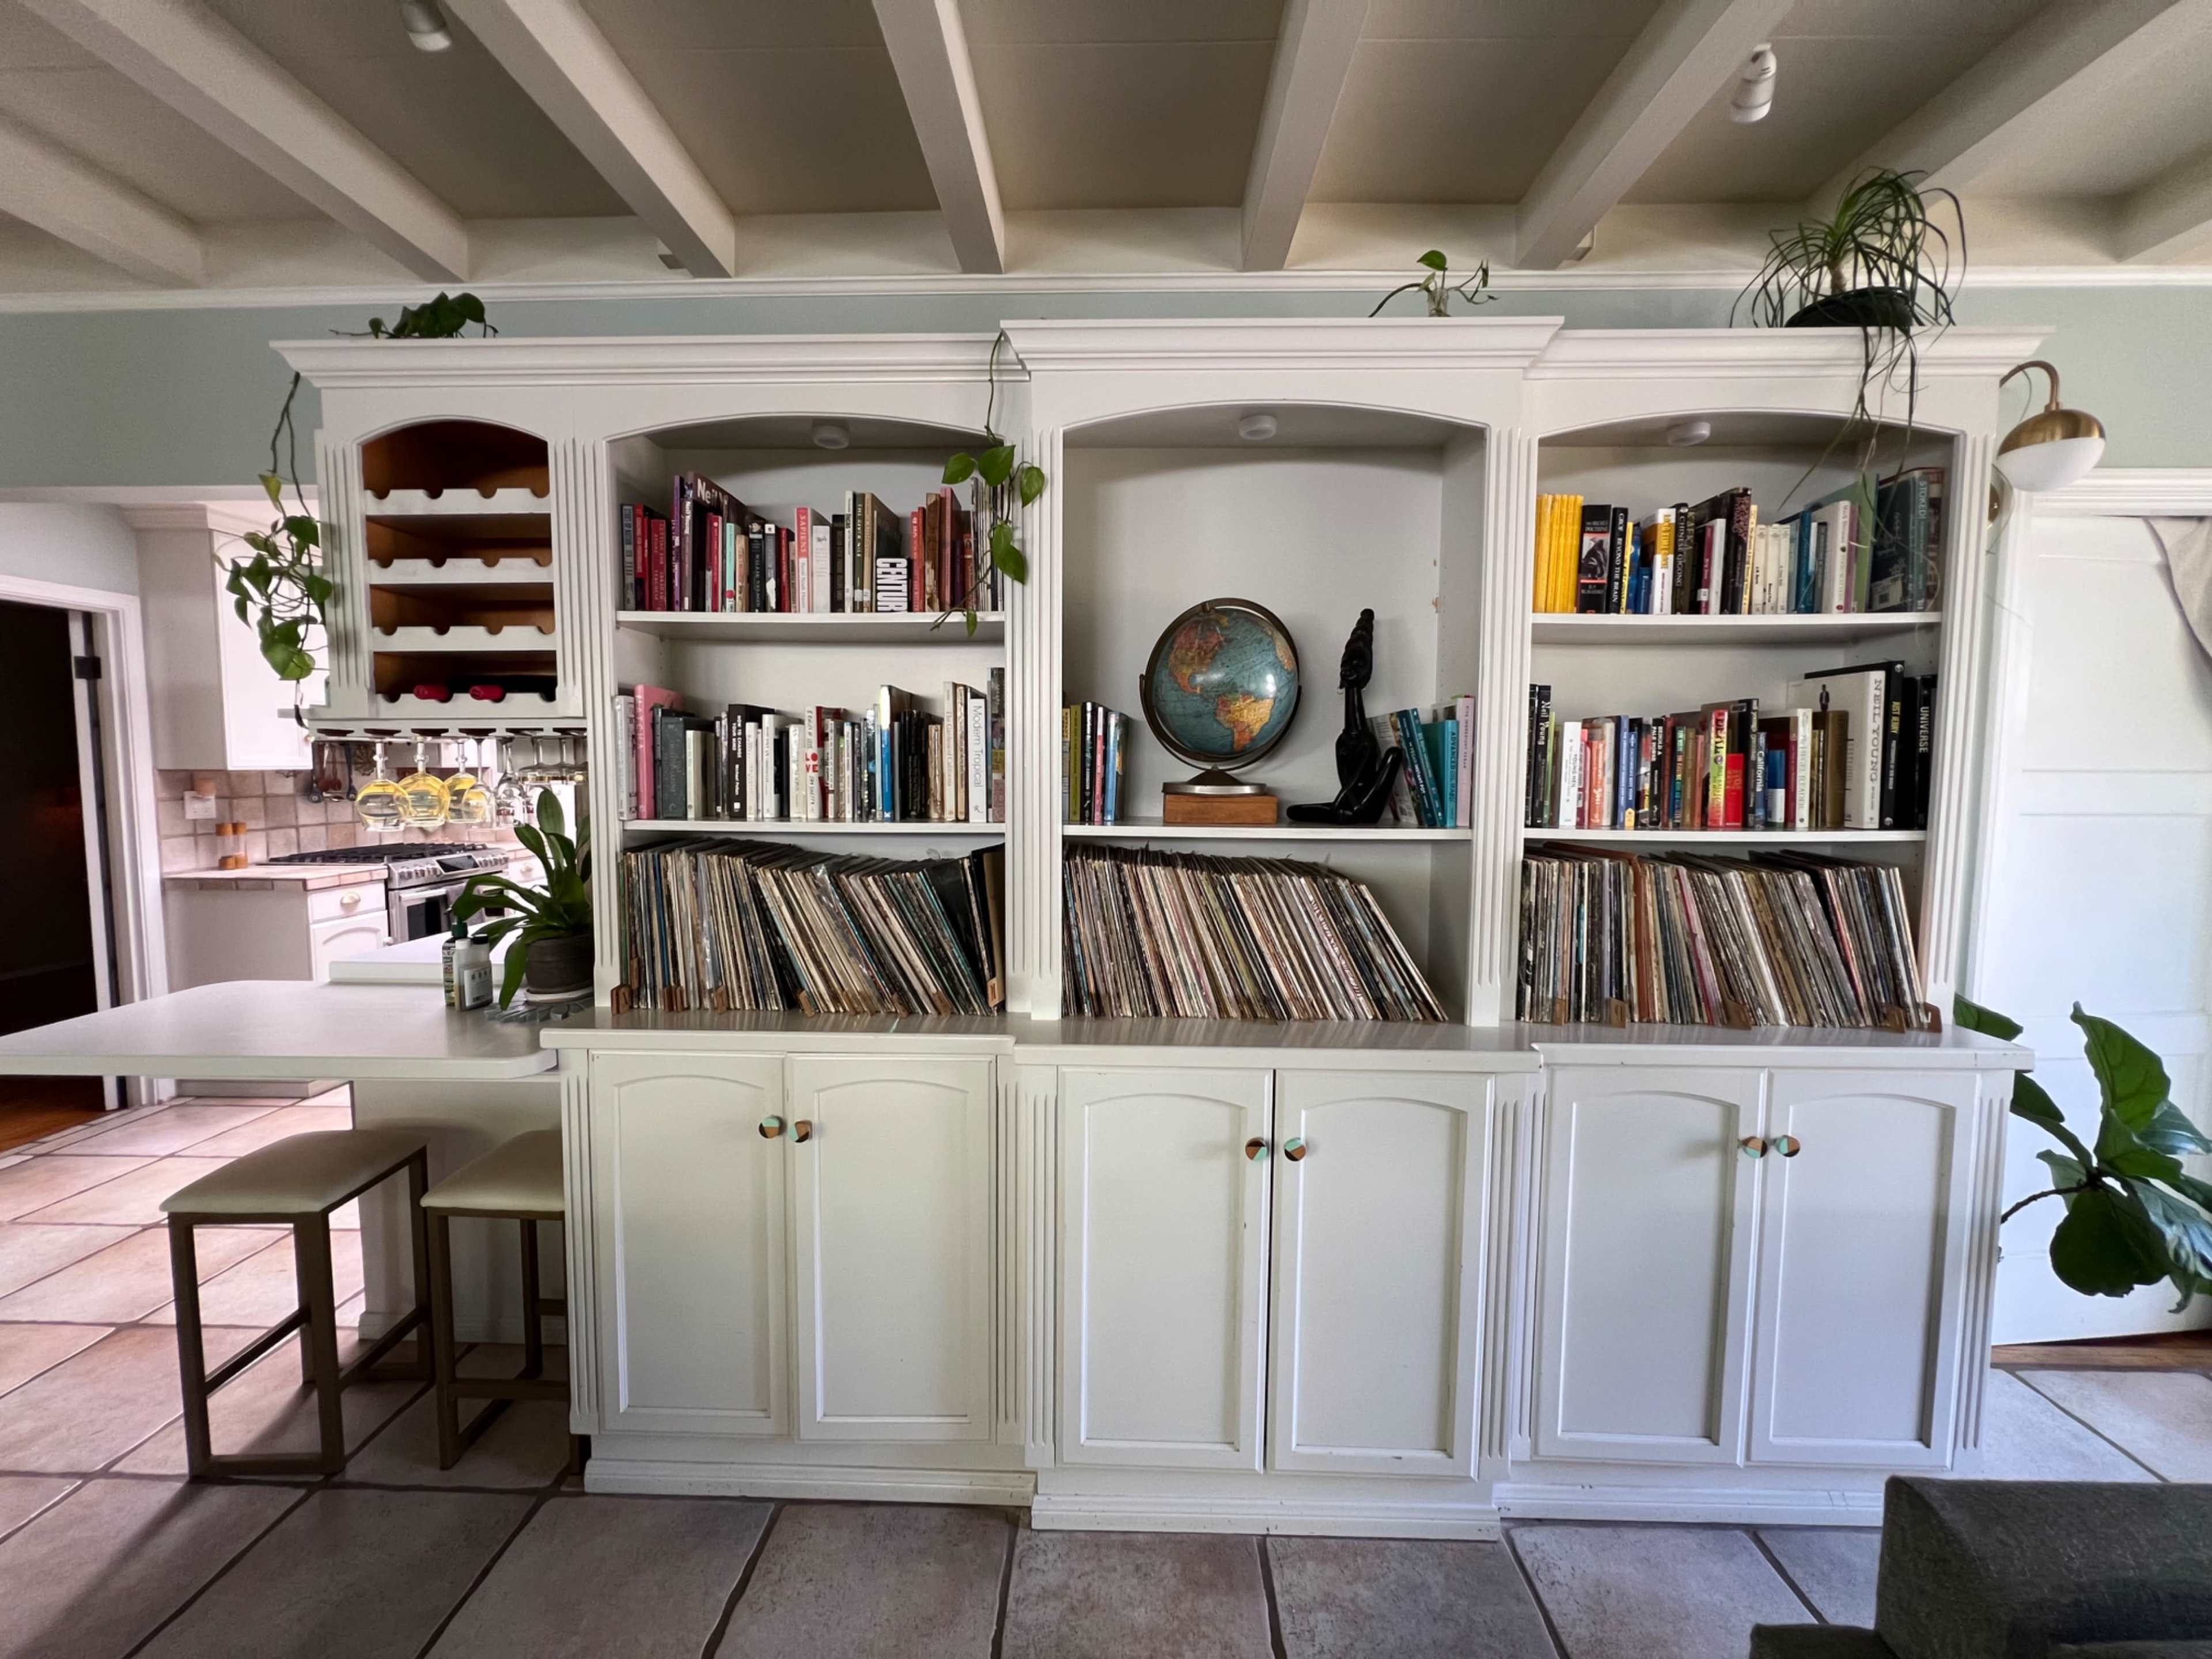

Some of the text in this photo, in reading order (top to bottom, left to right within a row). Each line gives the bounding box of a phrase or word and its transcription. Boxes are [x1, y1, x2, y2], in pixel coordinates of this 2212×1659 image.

[681, 515, 691, 535] Young
[1676, 516, 1685, 586] CHINESE QIGONG
[876, 558, 908, 613] CENTUR
[1540, 700, 1551, 718] Neil
[1873, 679, 1883, 723] NEIL
[971, 706, 983, 787] Modern Tropical
[1538, 721, 1550, 745] Young
[1714, 718, 1725, 754] DEAL
[1919, 706, 1930, 753] UNIVERSE
[1414, 764, 1423, 783] INSTANT
[1756, 751, 1764, 792] California
[1870, 724, 1881, 784] YOUNG
